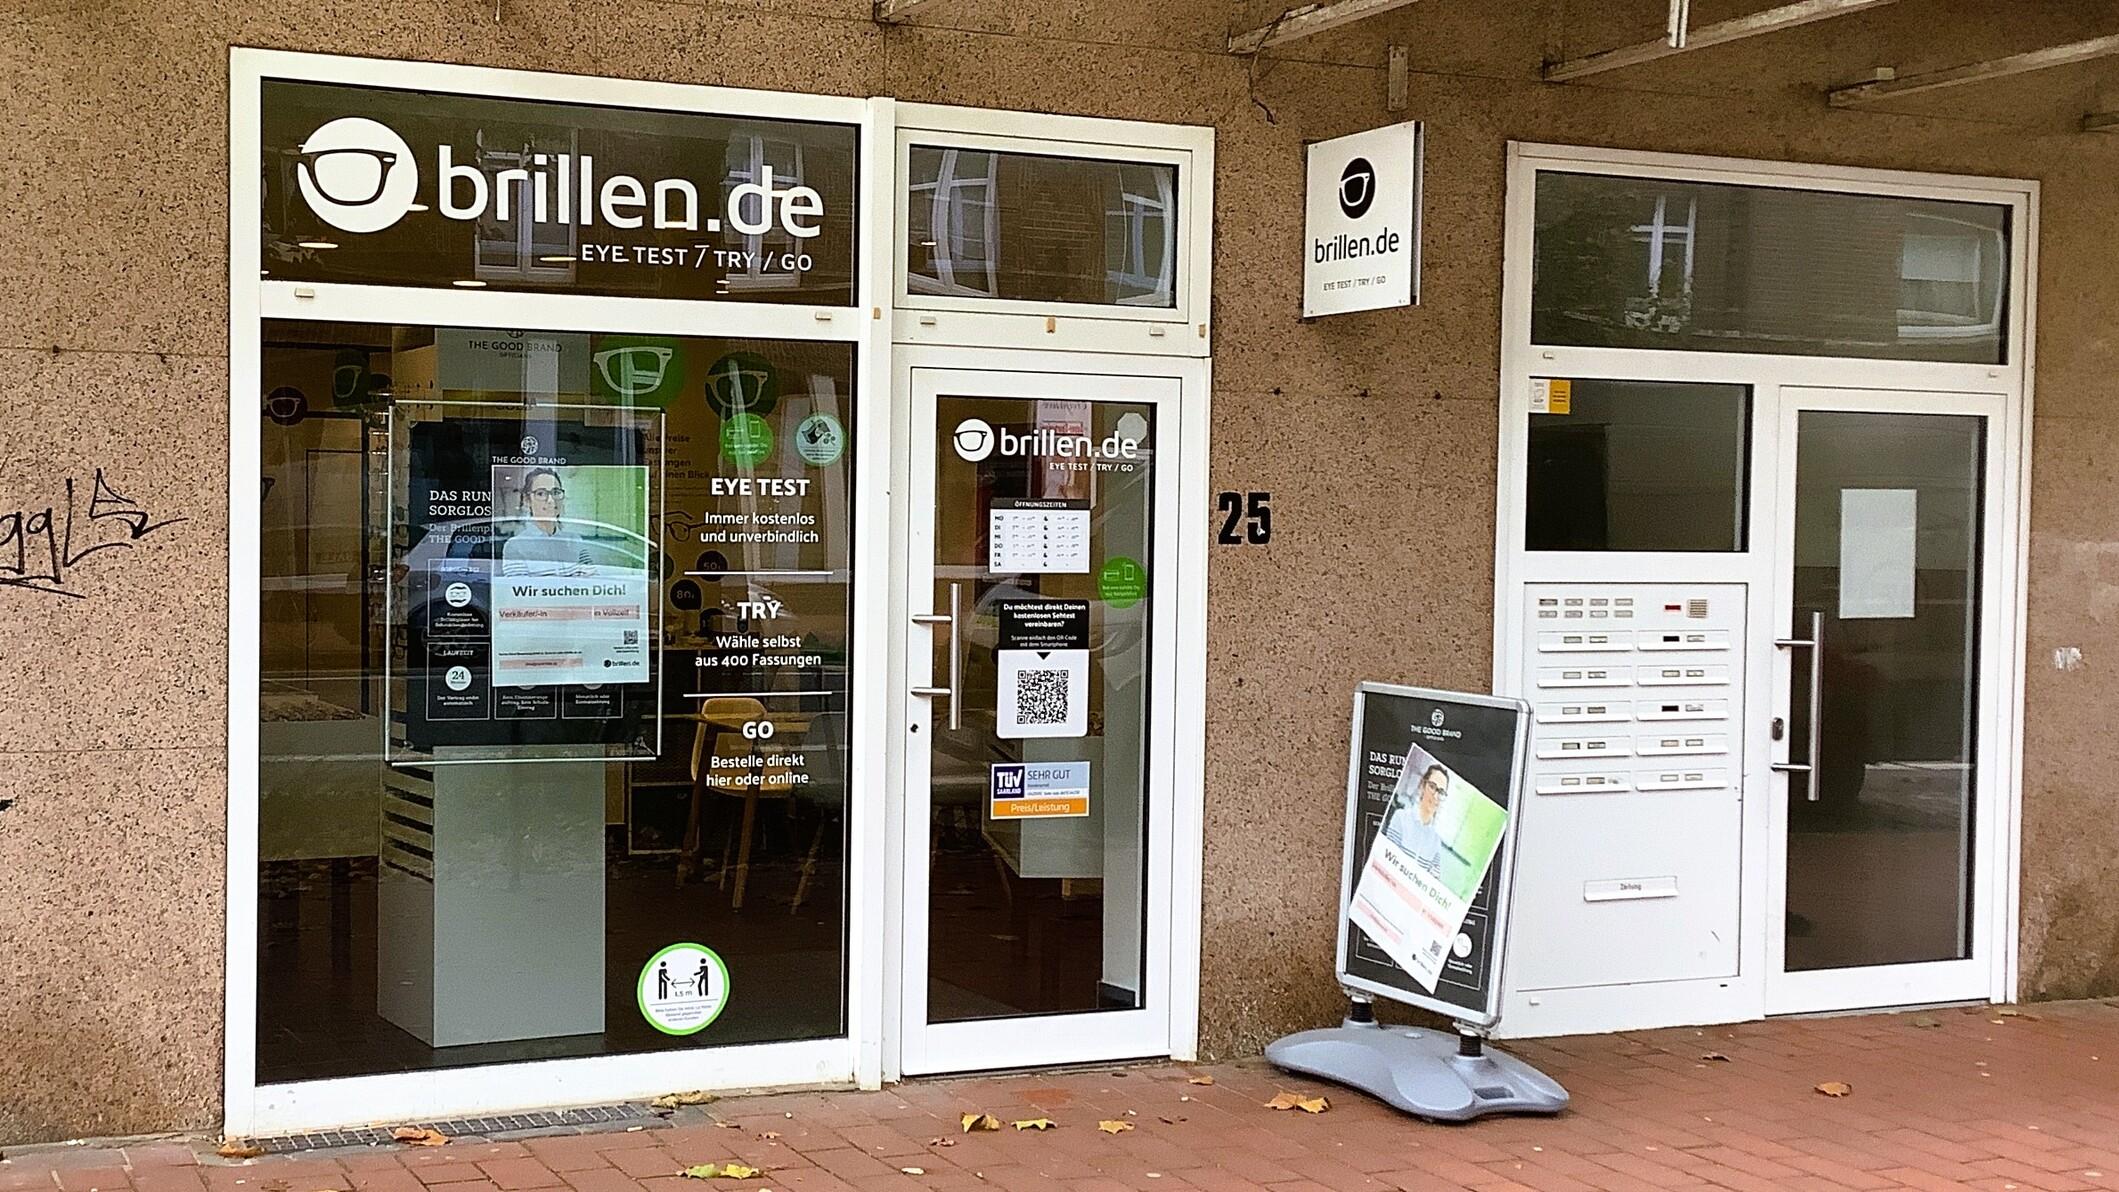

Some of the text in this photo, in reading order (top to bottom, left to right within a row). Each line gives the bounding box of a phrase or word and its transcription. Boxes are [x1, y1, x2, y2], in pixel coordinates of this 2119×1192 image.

[439, 144, 824, 238] brillen.de
[1314, 226, 1399, 263] brillen.de
[582, 244, 622, 262] EYE
[633, 247, 688, 266] TEST
[713, 250, 756, 269] TRY
[781, 253, 812, 272] GO
[1323, 282, 1335, 291] EYE
[1337, 280, 1351, 289] TEST
[1358, 278, 1370, 287] TRY
[1376, 275, 1386, 285] GO
[468, 340, 562, 353] THE GOOD BRAND
[1000, 427, 1138, 459] brillen.de
[492, 455, 567, 465] THE GOOD BRAND
[1050, 462, 1065, 471] EYE
[1068, 463, 1088, 471] TEST
[1097, 463, 1112, 472] TRY
[1121, 464, 1134, 472] GO
[711, 478, 752, 496] EYE
[757, 479, 811, 497] TEST
[429, 490, 457, 501] DAS
[429, 505, 492, 516] SORGLOS
[705, 512, 815, 525] Immer kostenlos
[1217, 491, 1271, 545] 25
[429, 523, 447, 532] Der
[429, 534, 485, 544] THE GOOD
[700, 530, 819, 543] und unverbindlich
[512, 584, 626, 597] Wir suchen Dich!
[737, 602, 781, 620] TRY
[716, 635, 801, 648] Wähle selbst
[612, 659, 640, 667] brillen.de
[695, 654, 822, 668] aus 400 Fassungen
[452, 671, 465, 680] 24
[742, 721, 774, 739] GO
[1422, 727, 1441, 735] GOOD
[711, 754, 805, 769] Bestelle direkt
[1369, 751, 1387, 763] DAS
[706, 772, 809, 787] hier oder online
[996, 769, 1023, 788] TÜV
[1027, 770, 1051, 781] SEHR
[1052, 769, 1071, 780] GUT
[1010, 803, 1070, 813] Preis/Leistung
[1384, 848, 1399, 866] Wir
[1399, 864, 1428, 892] suchen
[1429, 887, 1452, 911] Dich!
